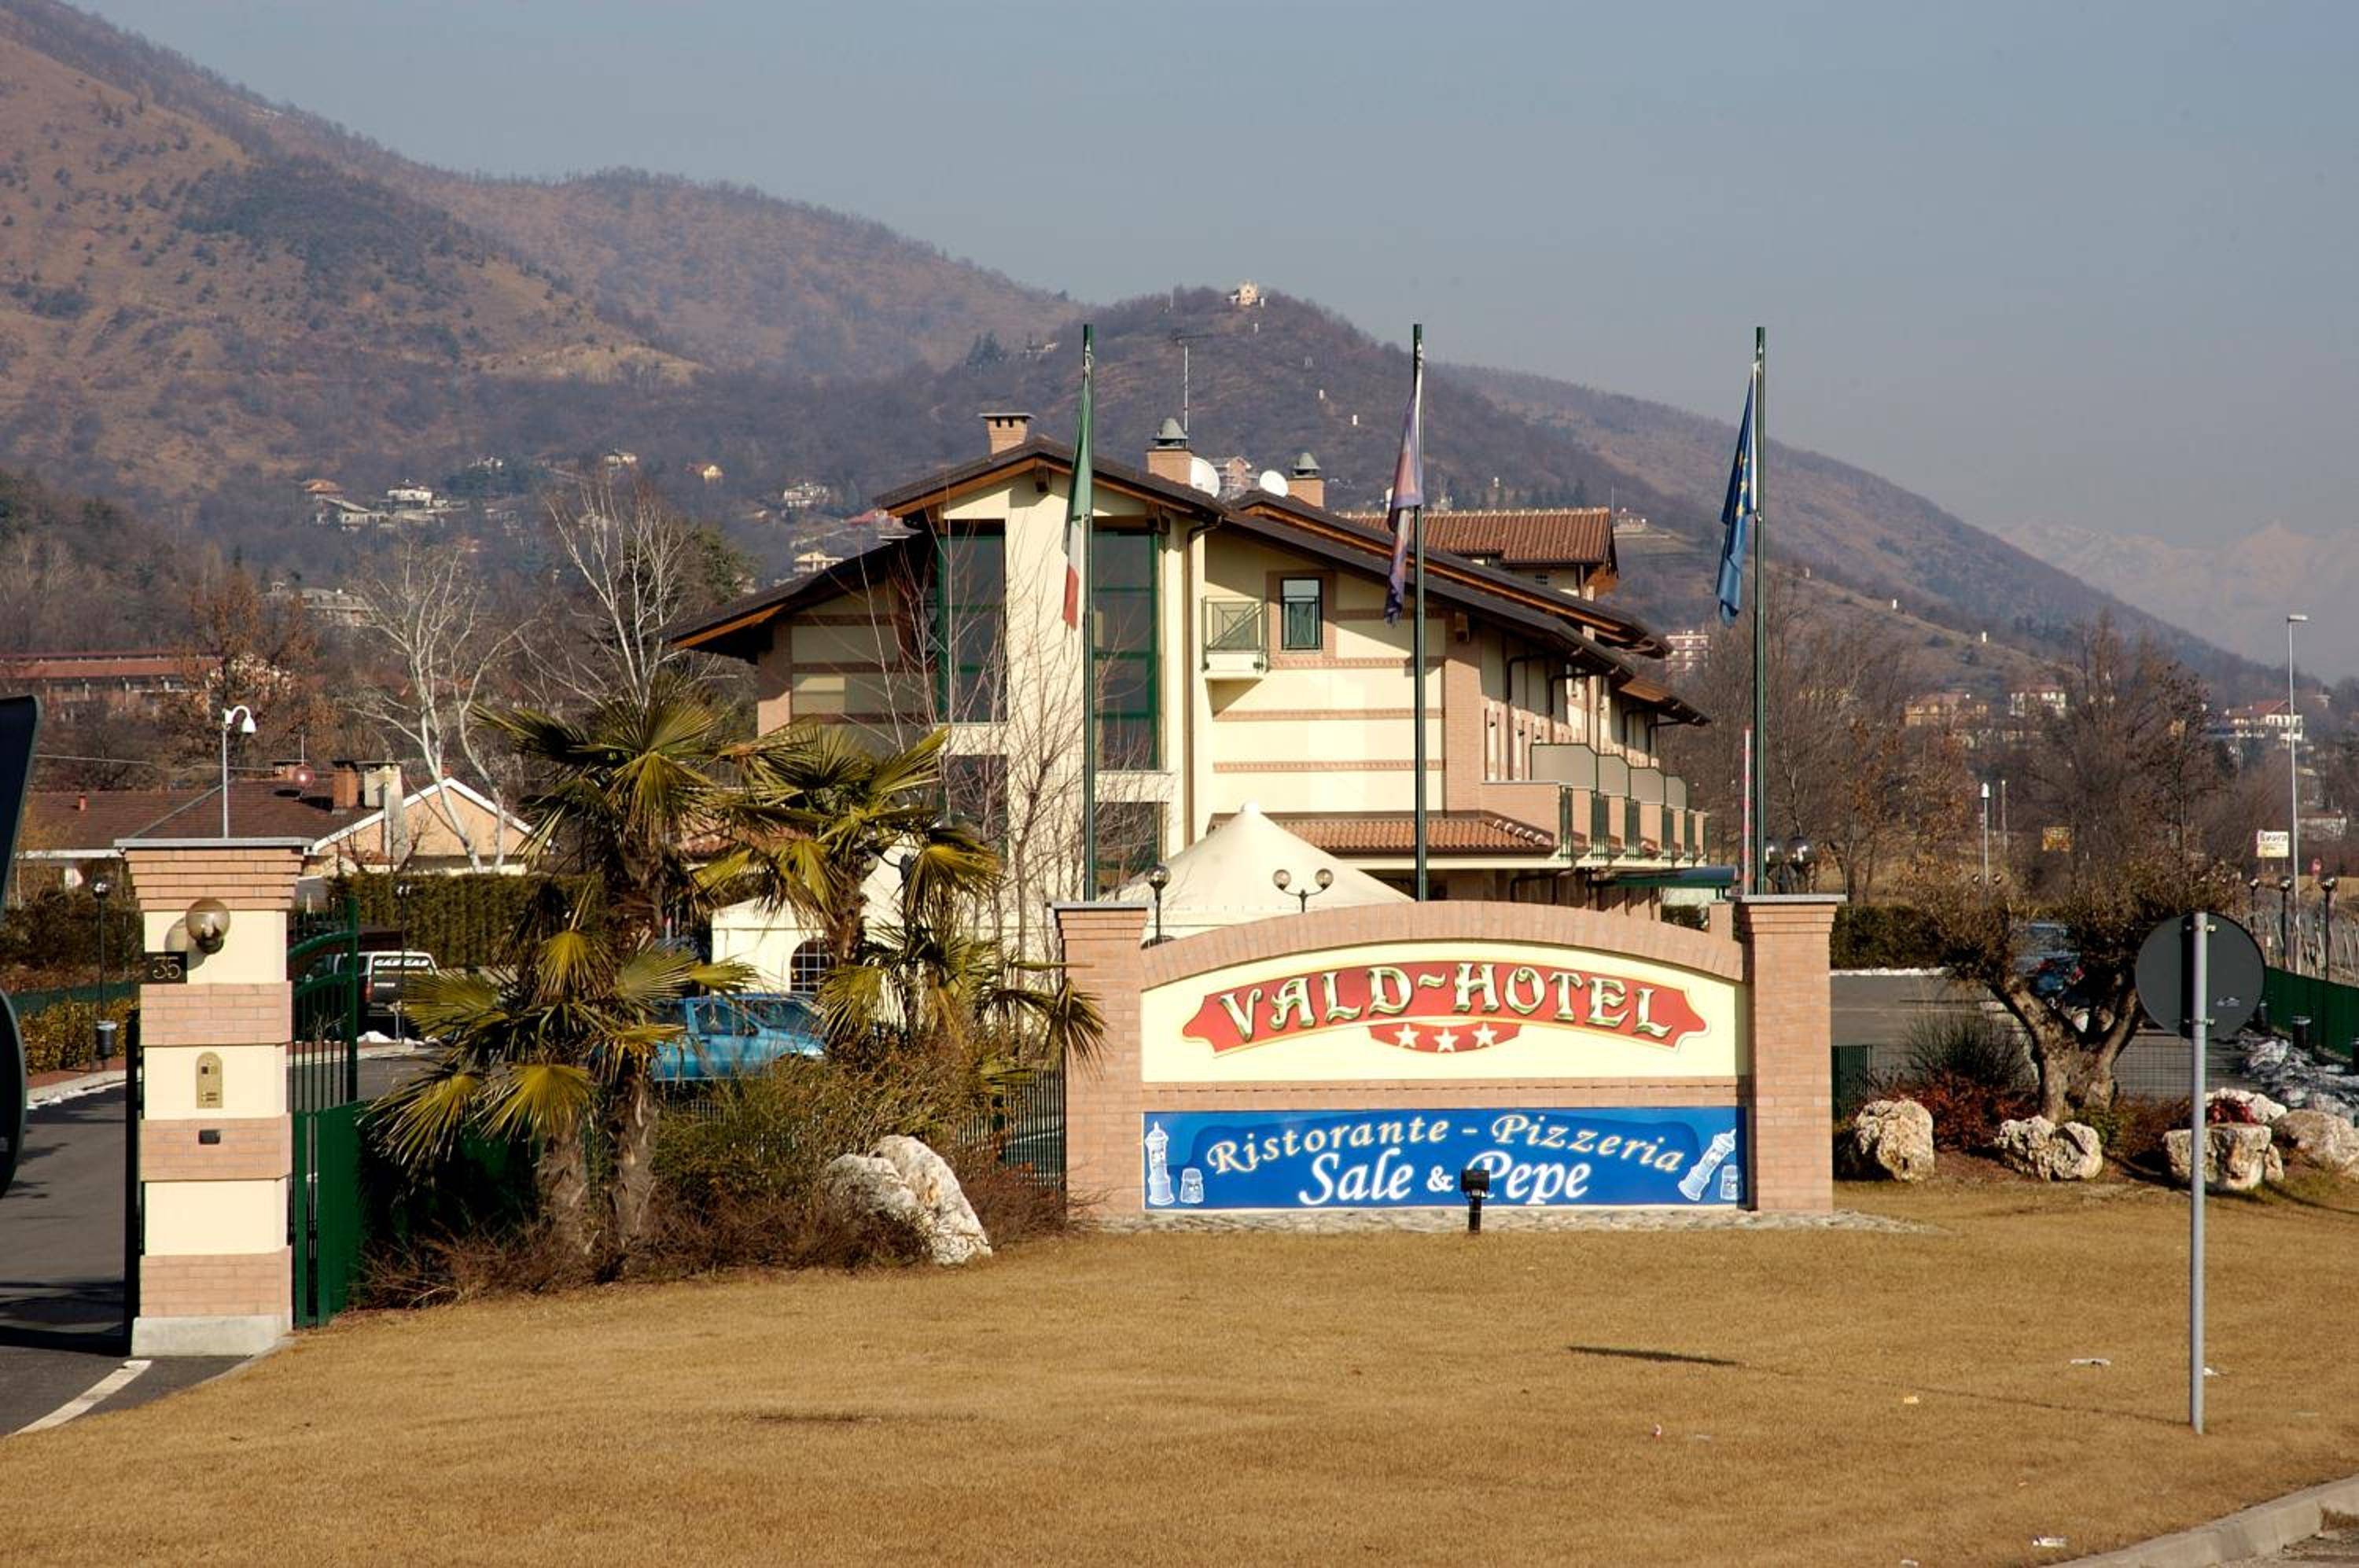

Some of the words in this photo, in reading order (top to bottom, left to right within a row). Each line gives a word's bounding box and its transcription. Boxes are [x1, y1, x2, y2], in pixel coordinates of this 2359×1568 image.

[152, 955, 182, 980] 35
[1207, 1116, 1449, 1175] Ristorante
[1492, 1113, 1685, 1173] Pizzeria
[1298, 1147, 1415, 1205] Sale
[1426, 1165, 1455, 1193] &
[1466, 1150, 1592, 1205] Pepe
